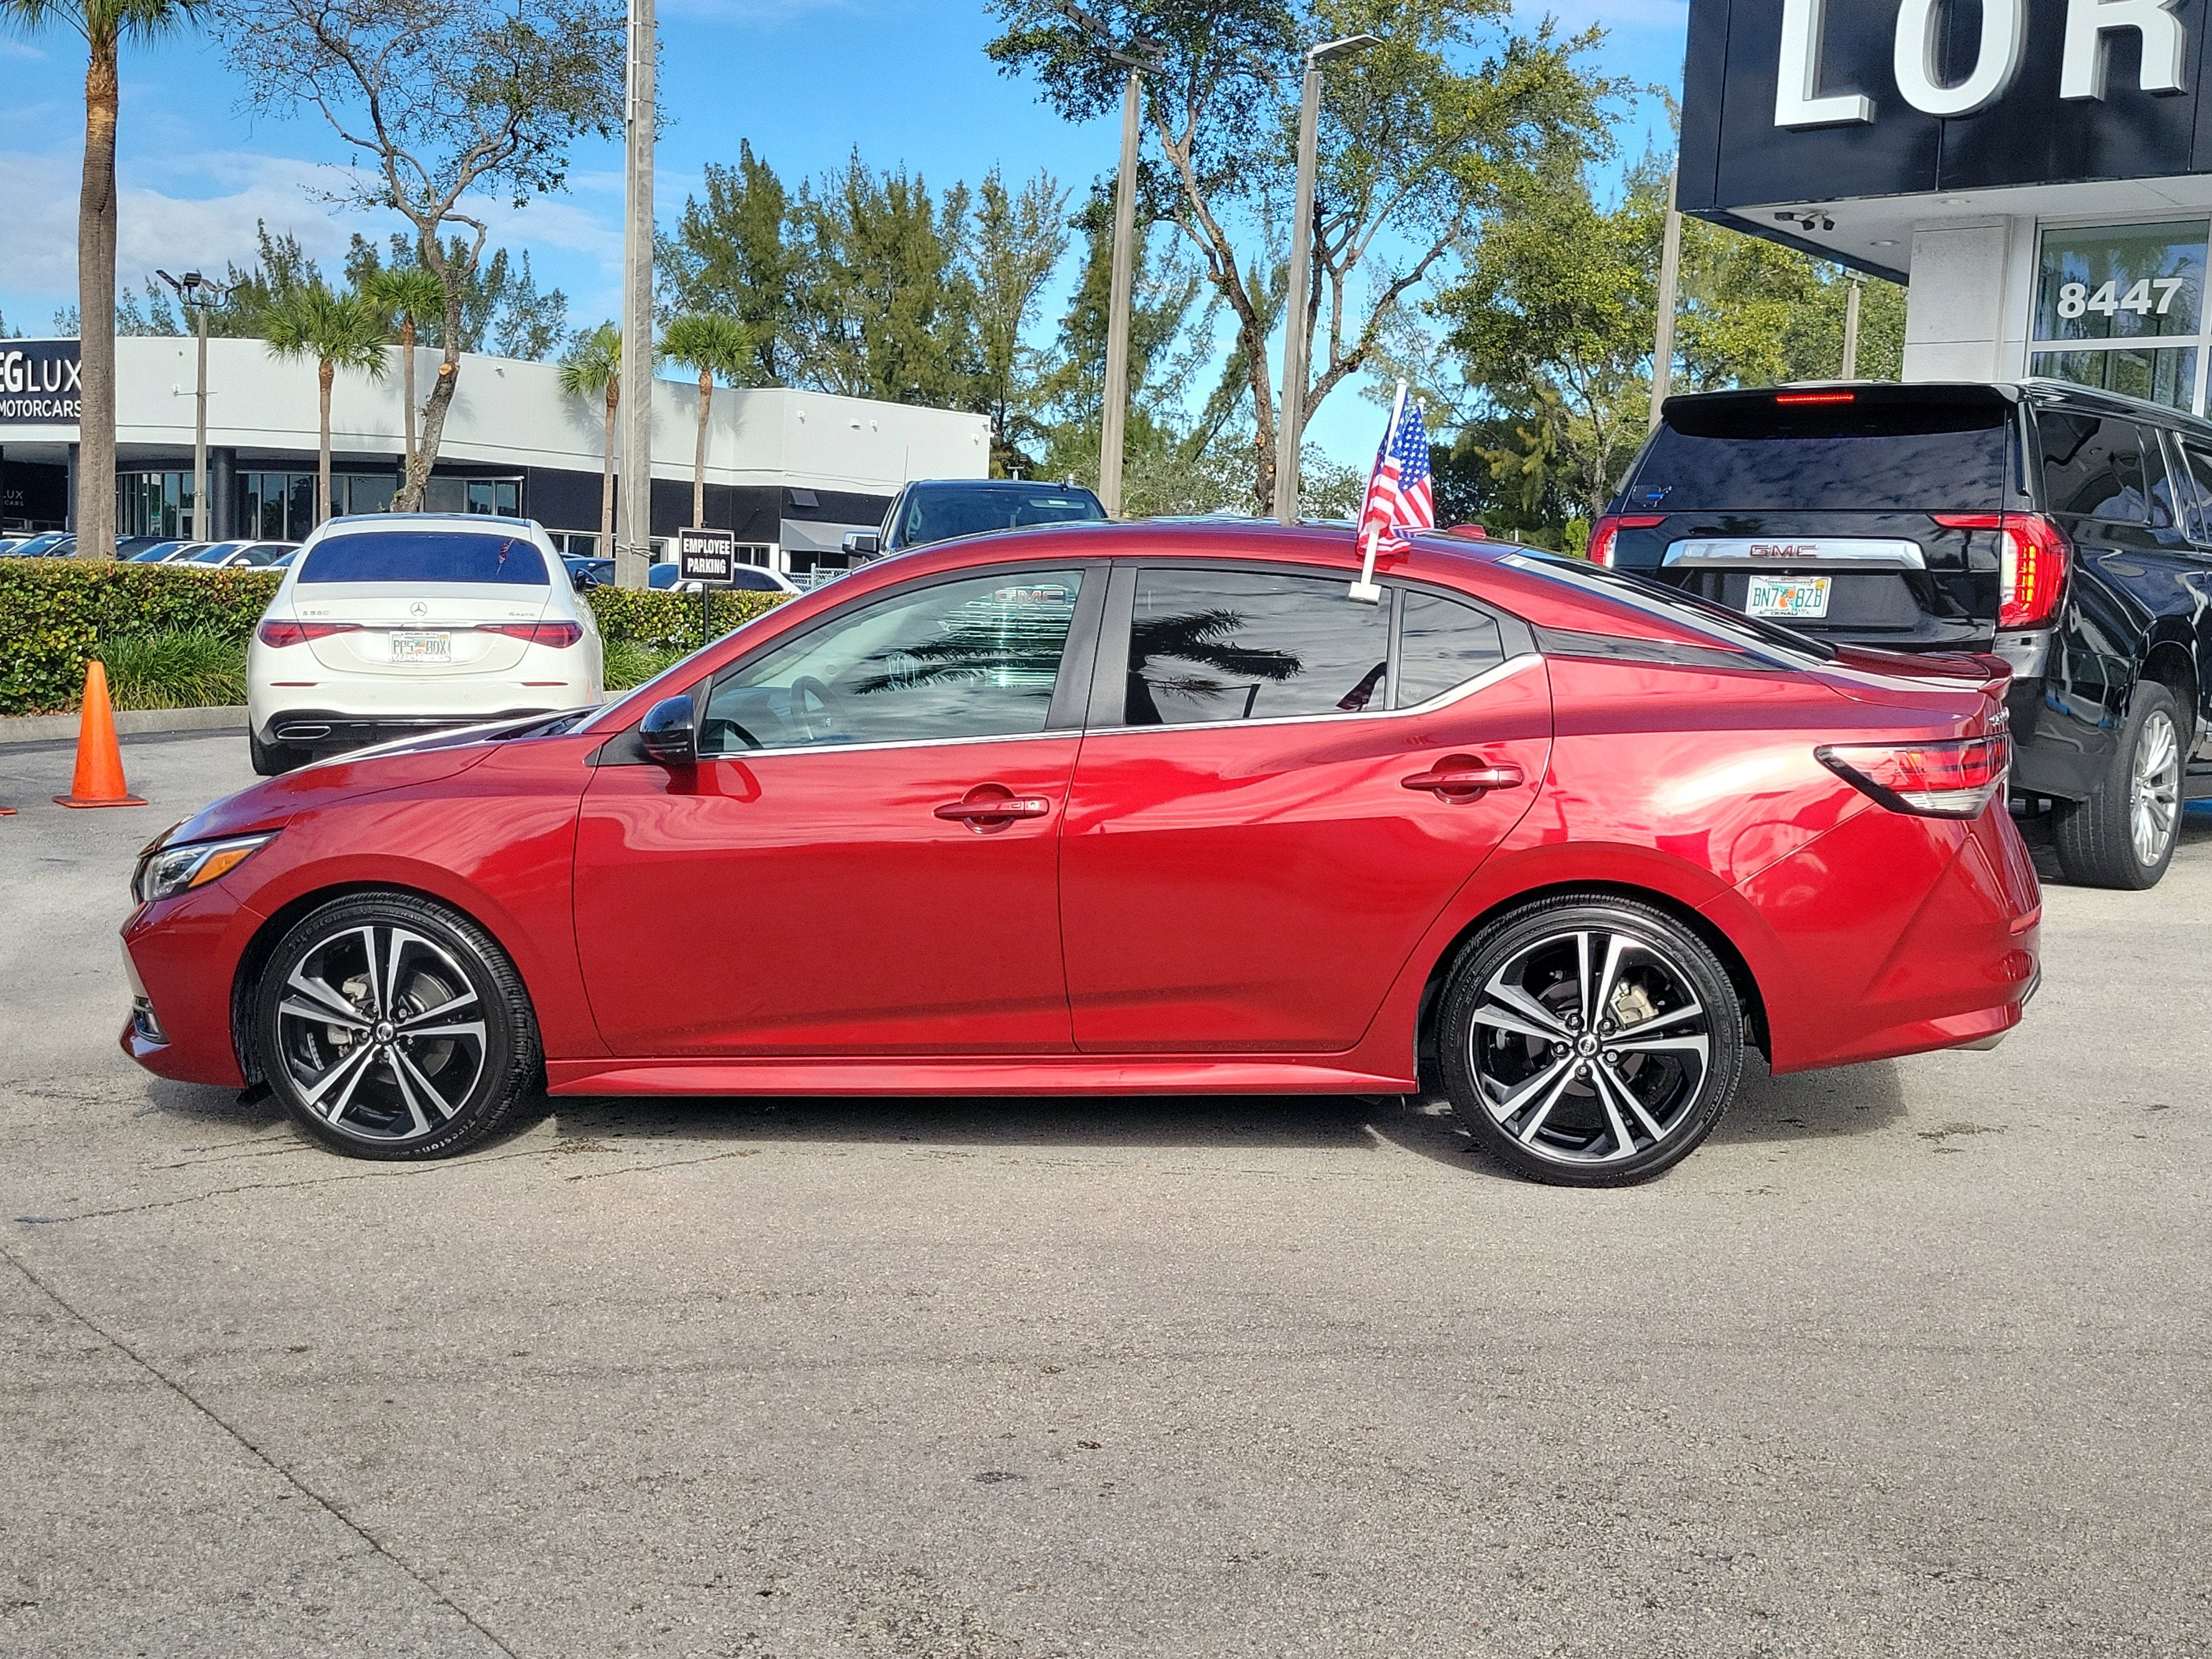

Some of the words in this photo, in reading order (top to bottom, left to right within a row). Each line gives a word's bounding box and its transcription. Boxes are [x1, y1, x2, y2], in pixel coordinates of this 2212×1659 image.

[2057, 278, 2183, 318] 8447
[0, 399, 82, 417] MOTORCARS
[3, 490, 24, 499] UX
[683, 538, 731, 555] EMPLOYEE
[1750, 544, 1818, 558] GMC
[687, 557, 726, 574] PARKING
[995, 590, 1064, 604] GMC
[1752, 588, 1779, 607] BN7
